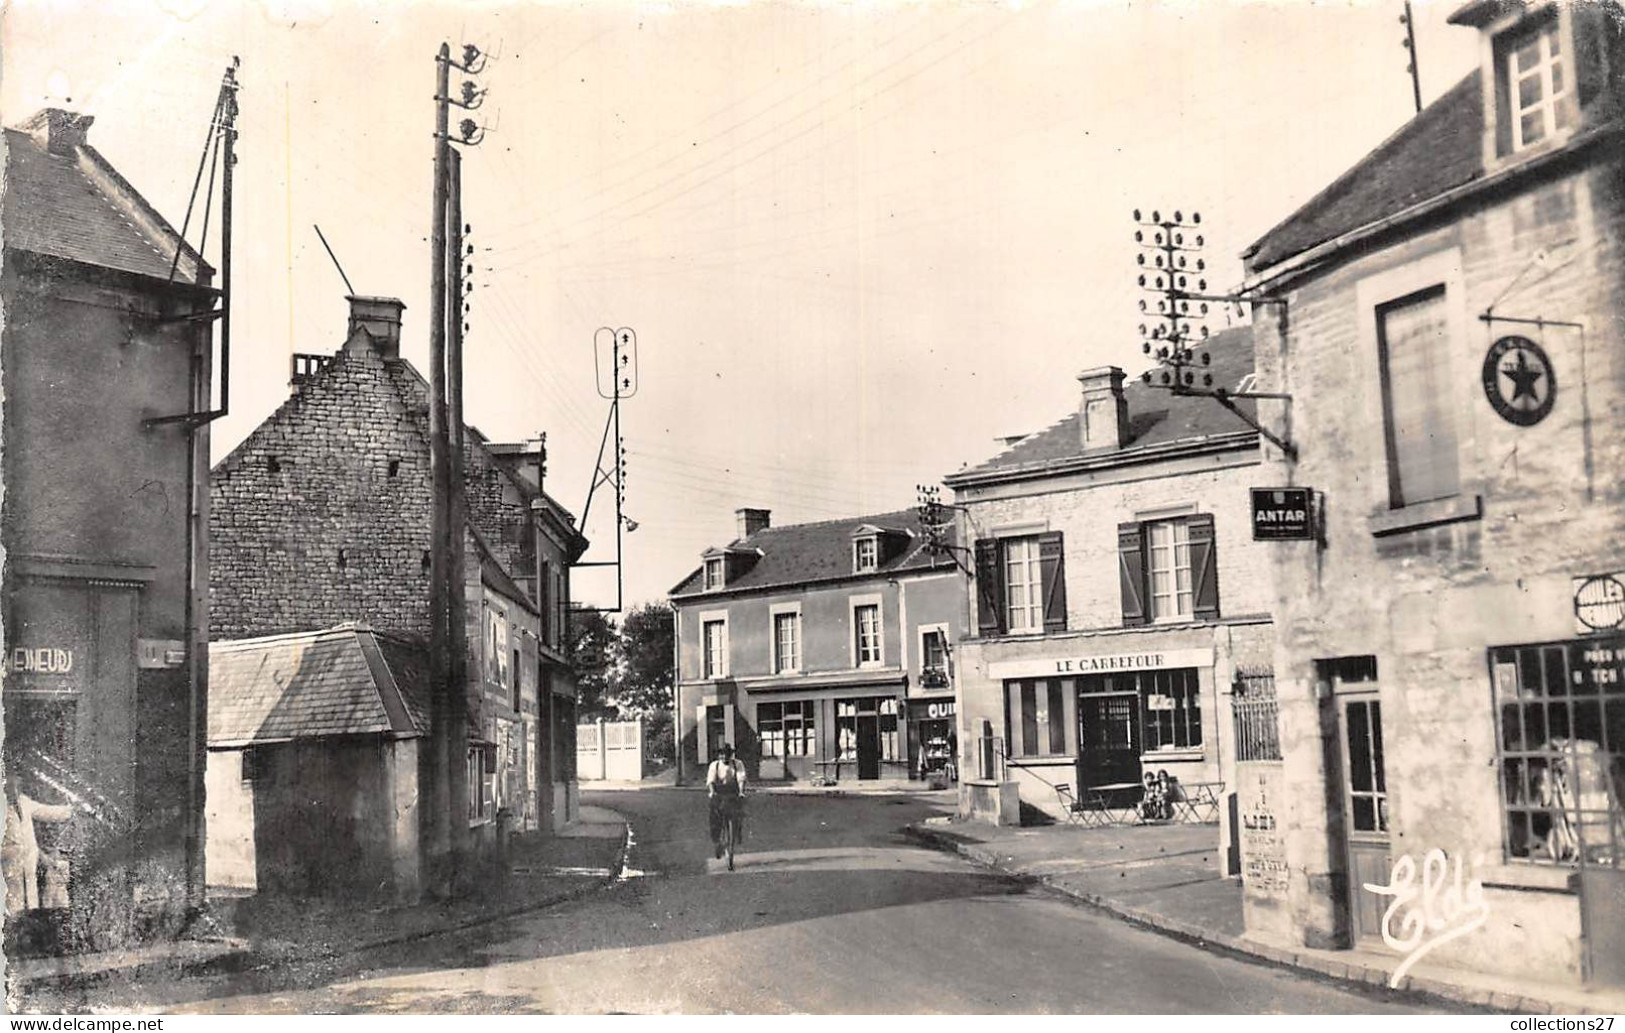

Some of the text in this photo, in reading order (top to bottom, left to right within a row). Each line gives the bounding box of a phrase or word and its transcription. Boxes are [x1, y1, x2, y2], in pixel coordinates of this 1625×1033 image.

[1256, 509, 1305, 522] ANTAR
[1056, 654, 1165, 673] LE CARREFOUR
